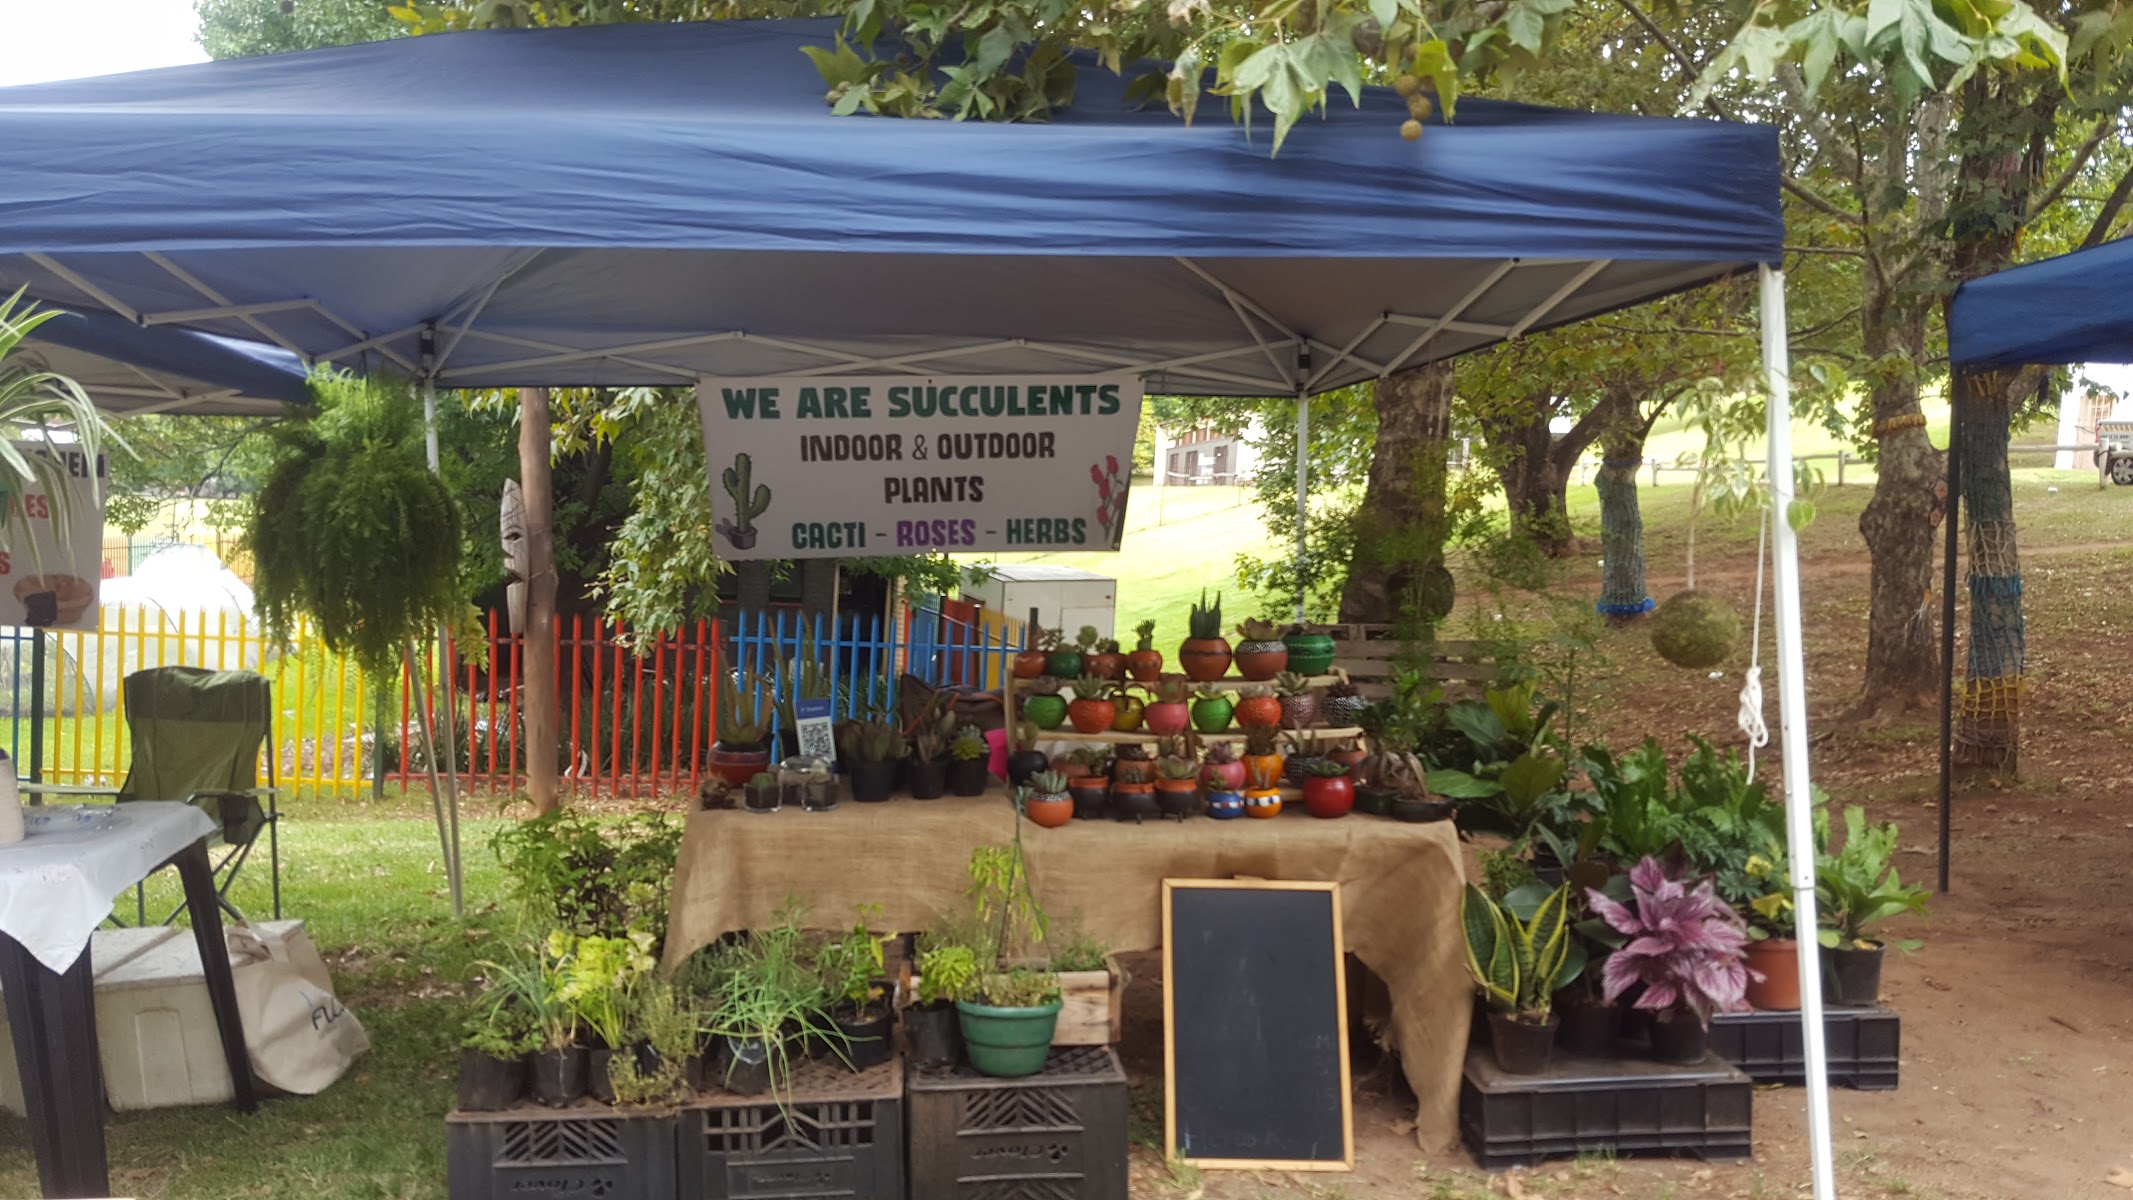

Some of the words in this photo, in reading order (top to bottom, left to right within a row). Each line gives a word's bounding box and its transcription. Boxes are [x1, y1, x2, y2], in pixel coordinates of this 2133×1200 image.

[721, 387, 781, 420] WE
[796, 386, 872, 419] ARE
[888, 384, 1121, 418] SUCCULENTS
[800, 433, 903, 462] INDOOR
[912, 433, 929, 461] &
[937, 431, 1056, 460] OUTDOOR
[883, 474, 984, 504] PLANTS
[791, 520, 866, 550] CACTI
[896, 518, 977, 548] ROSES
[1005, 516, 1088, 546] HERBS
